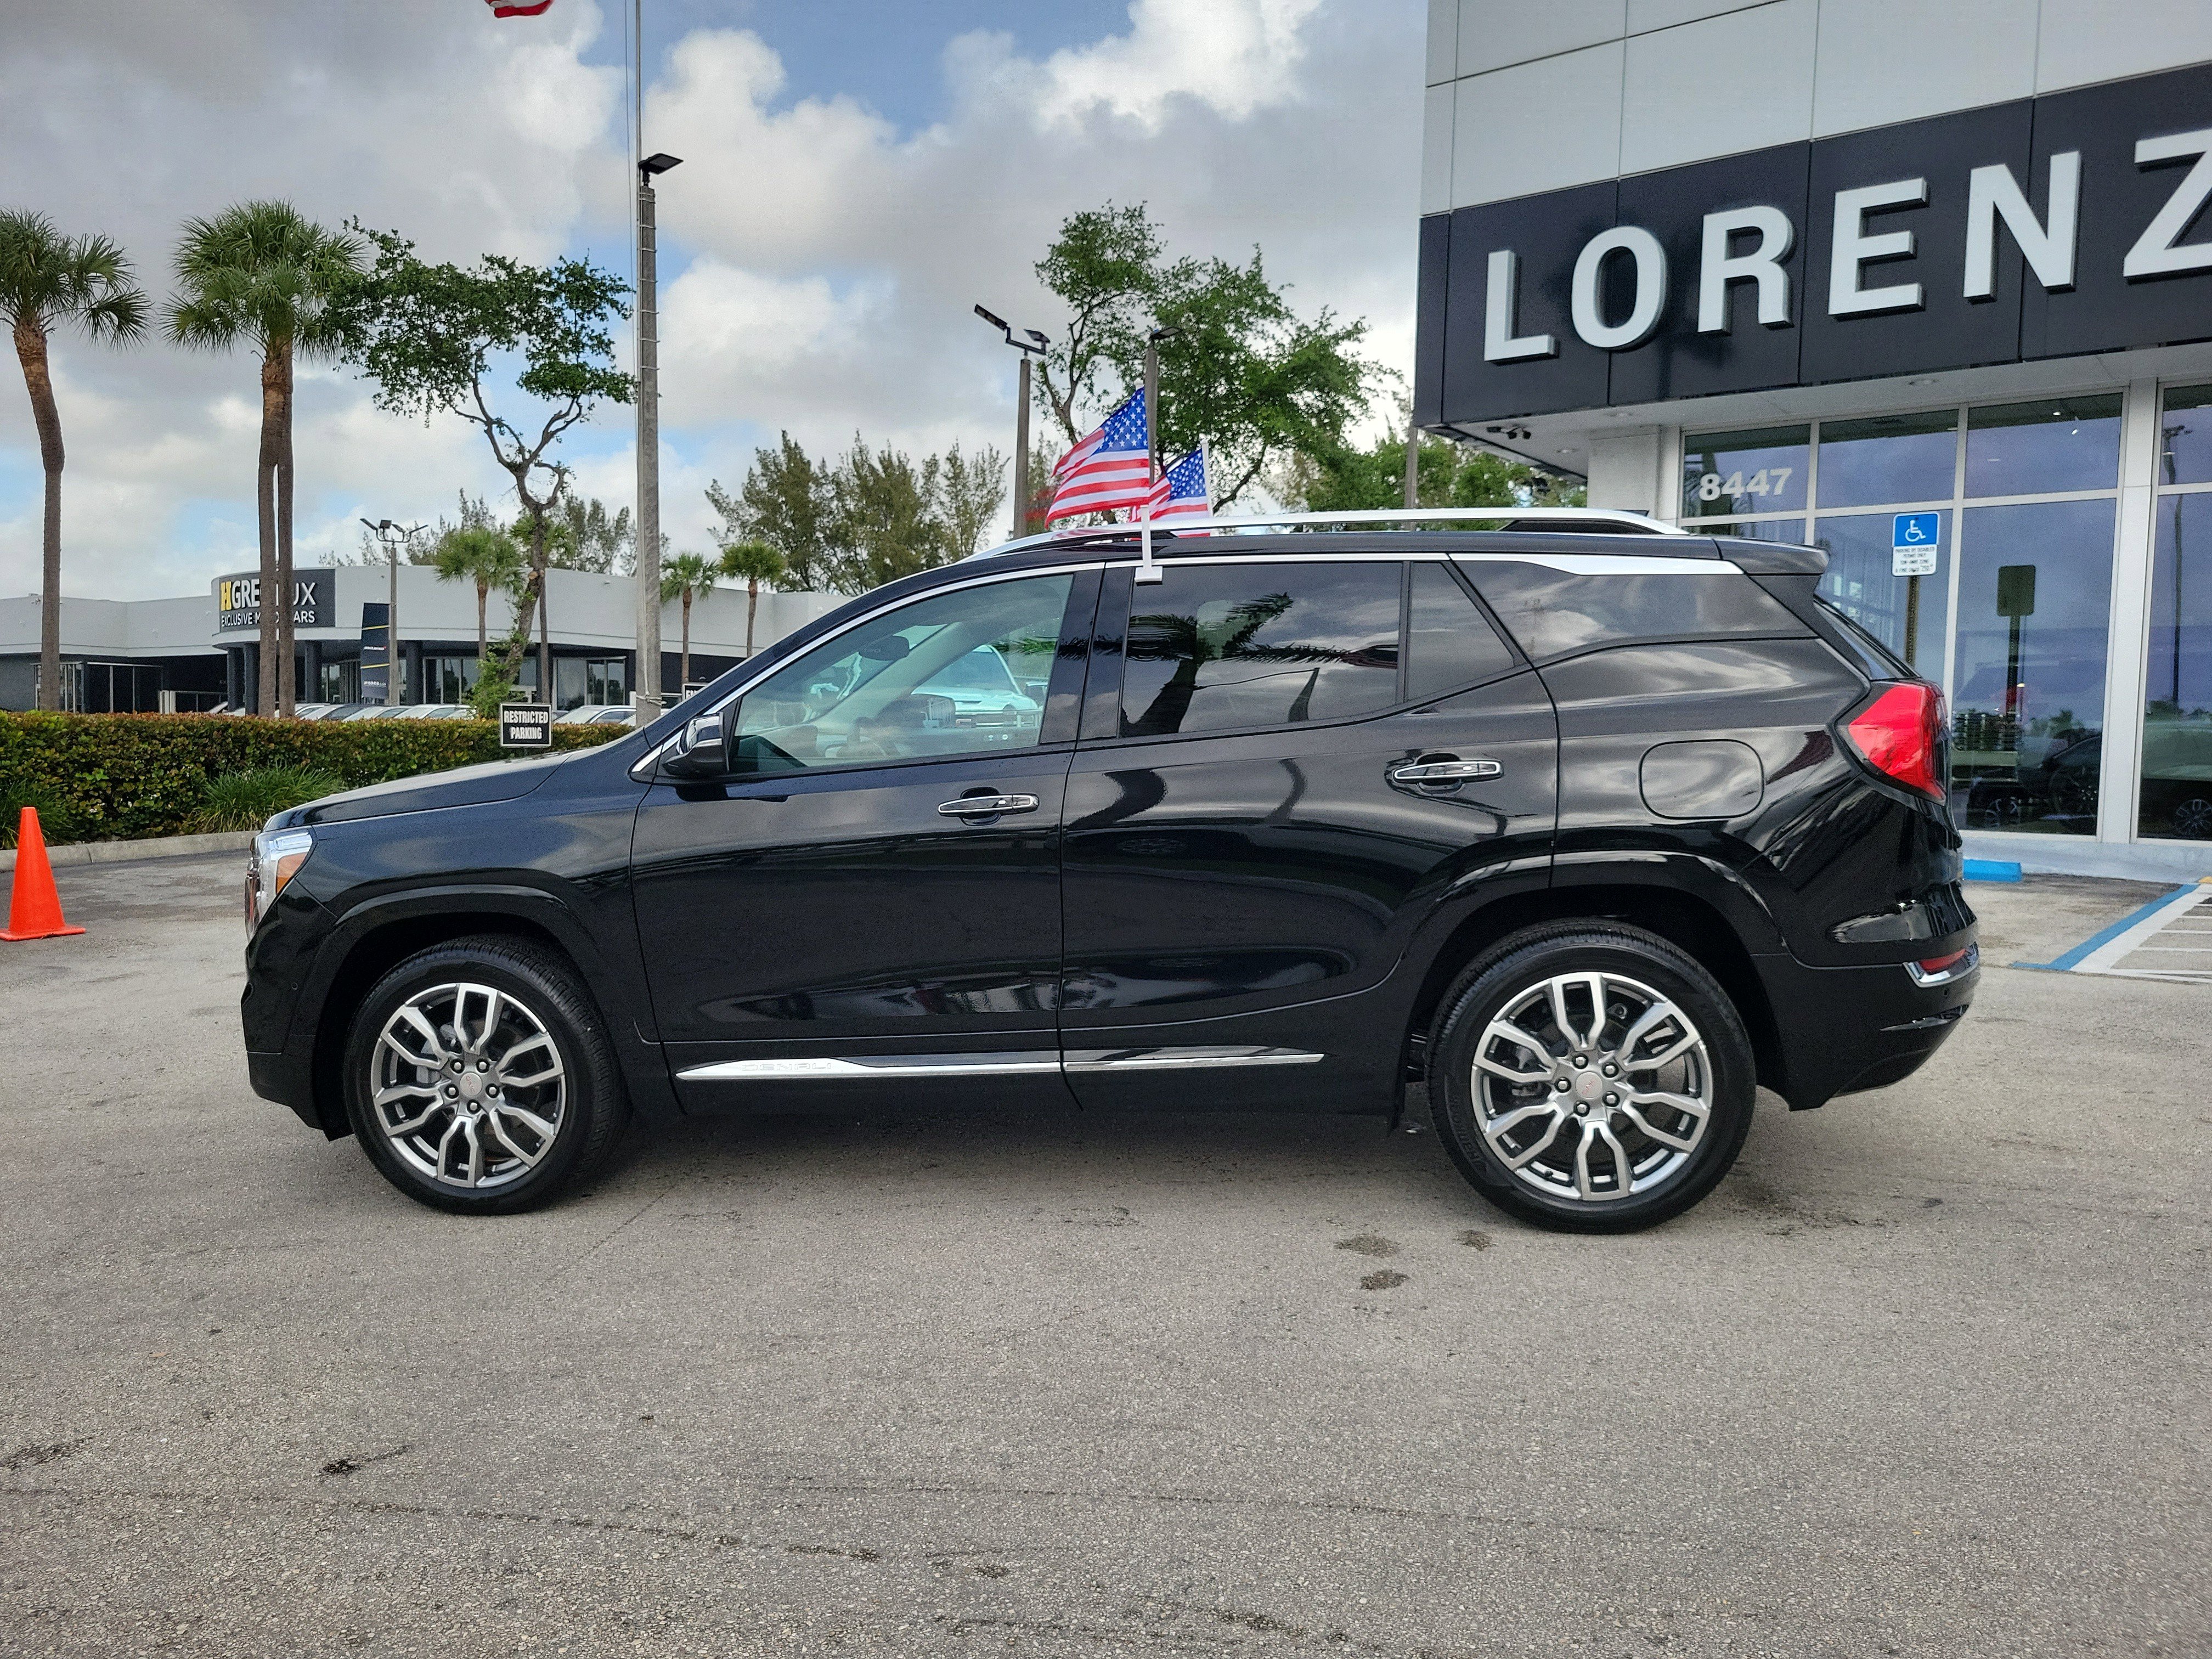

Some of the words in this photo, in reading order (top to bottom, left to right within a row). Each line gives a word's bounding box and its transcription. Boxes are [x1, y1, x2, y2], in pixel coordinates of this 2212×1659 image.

[1483, 128, 2212, 365] LORENZ
[1699, 468, 1792, 501] 8447
[222, 612, 253, 627] EXCLUSIVE
[293, 610, 315, 624] ARS
[504, 710, 549, 724] RESTRICTED
[510, 727, 543, 740] PARKING
[742, 1063, 831, 1071] DENALI
